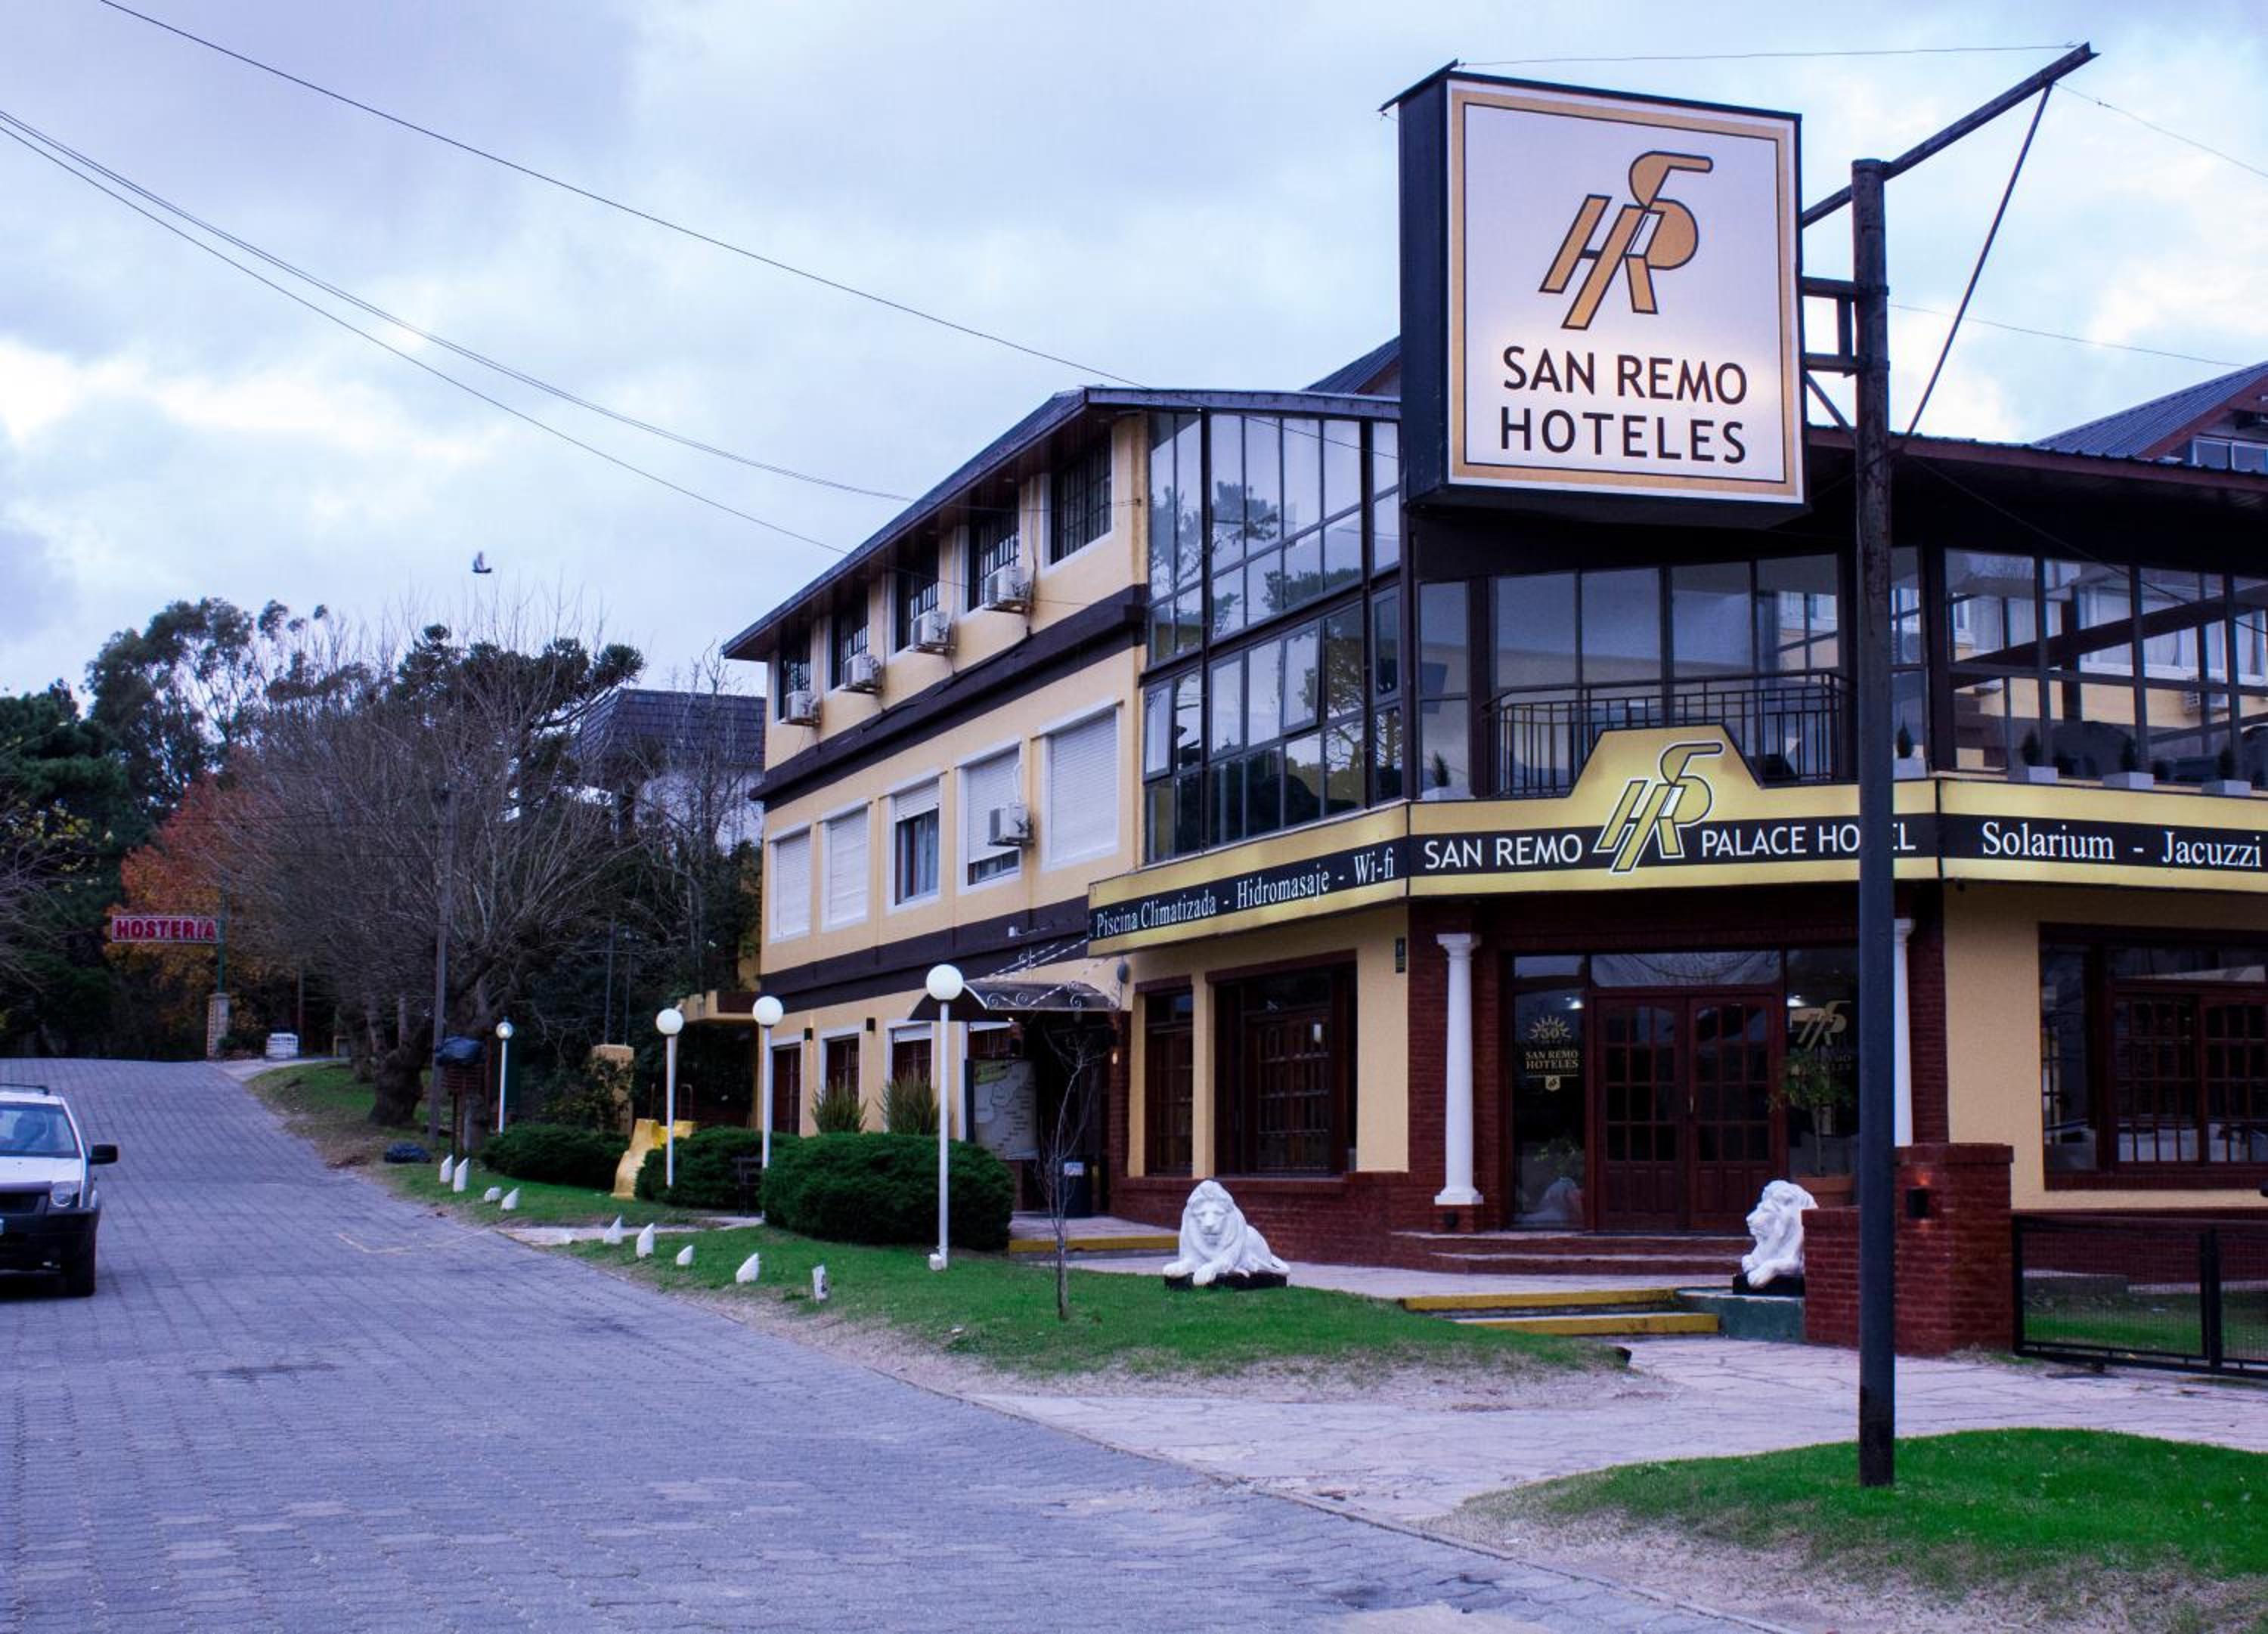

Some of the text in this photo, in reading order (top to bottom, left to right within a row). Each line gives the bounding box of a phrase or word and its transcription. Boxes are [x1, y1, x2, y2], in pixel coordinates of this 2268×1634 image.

[1502, 345, 1747, 405] SAN REMO
[1500, 406, 1746, 463] HOTELES
[1424, 822, 1916, 871] SAN REMO PALACE HOL
[1981, 821, 2115, 859] Solarium
[2161, 831, 2263, 868] Jacuzzi
[1096, 907, 1138, 938] Piscina
[1140, 888, 1217, 928] Climatizada
[1236, 862, 1331, 910] Hidromasaje
[1353, 846, 1395, 886] Wi-fi
[115, 919, 216, 941] HOSTERIA
[1526, 1060, 1579, 1069] HOTELES
